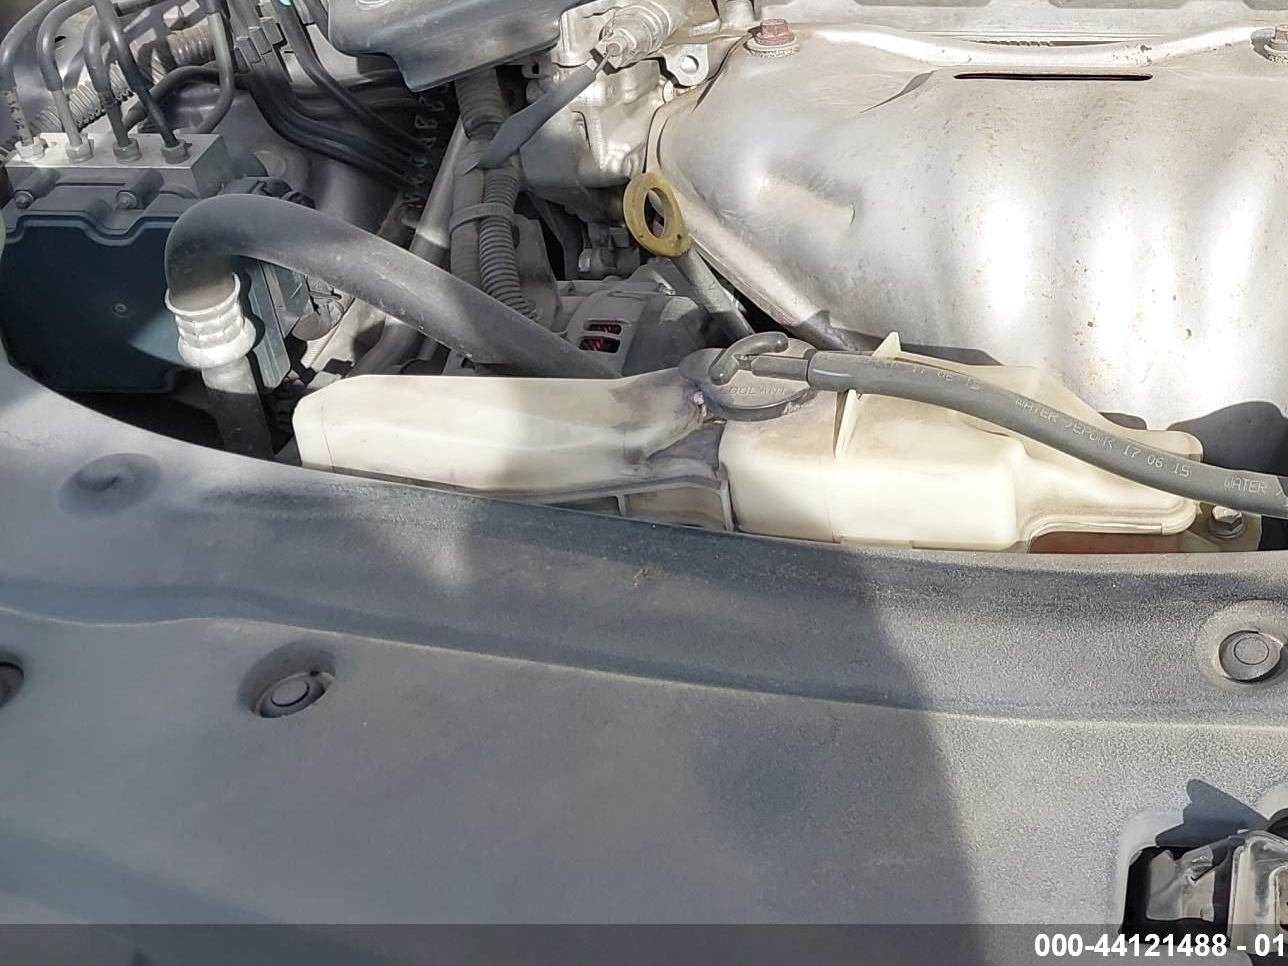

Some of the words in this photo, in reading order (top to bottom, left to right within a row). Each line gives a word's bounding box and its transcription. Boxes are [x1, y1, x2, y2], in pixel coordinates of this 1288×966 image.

[1147, 454, 1165, 469] 06
[1172, 462, 1192, 478] 15
[1222, 476, 1268, 496] WATER
